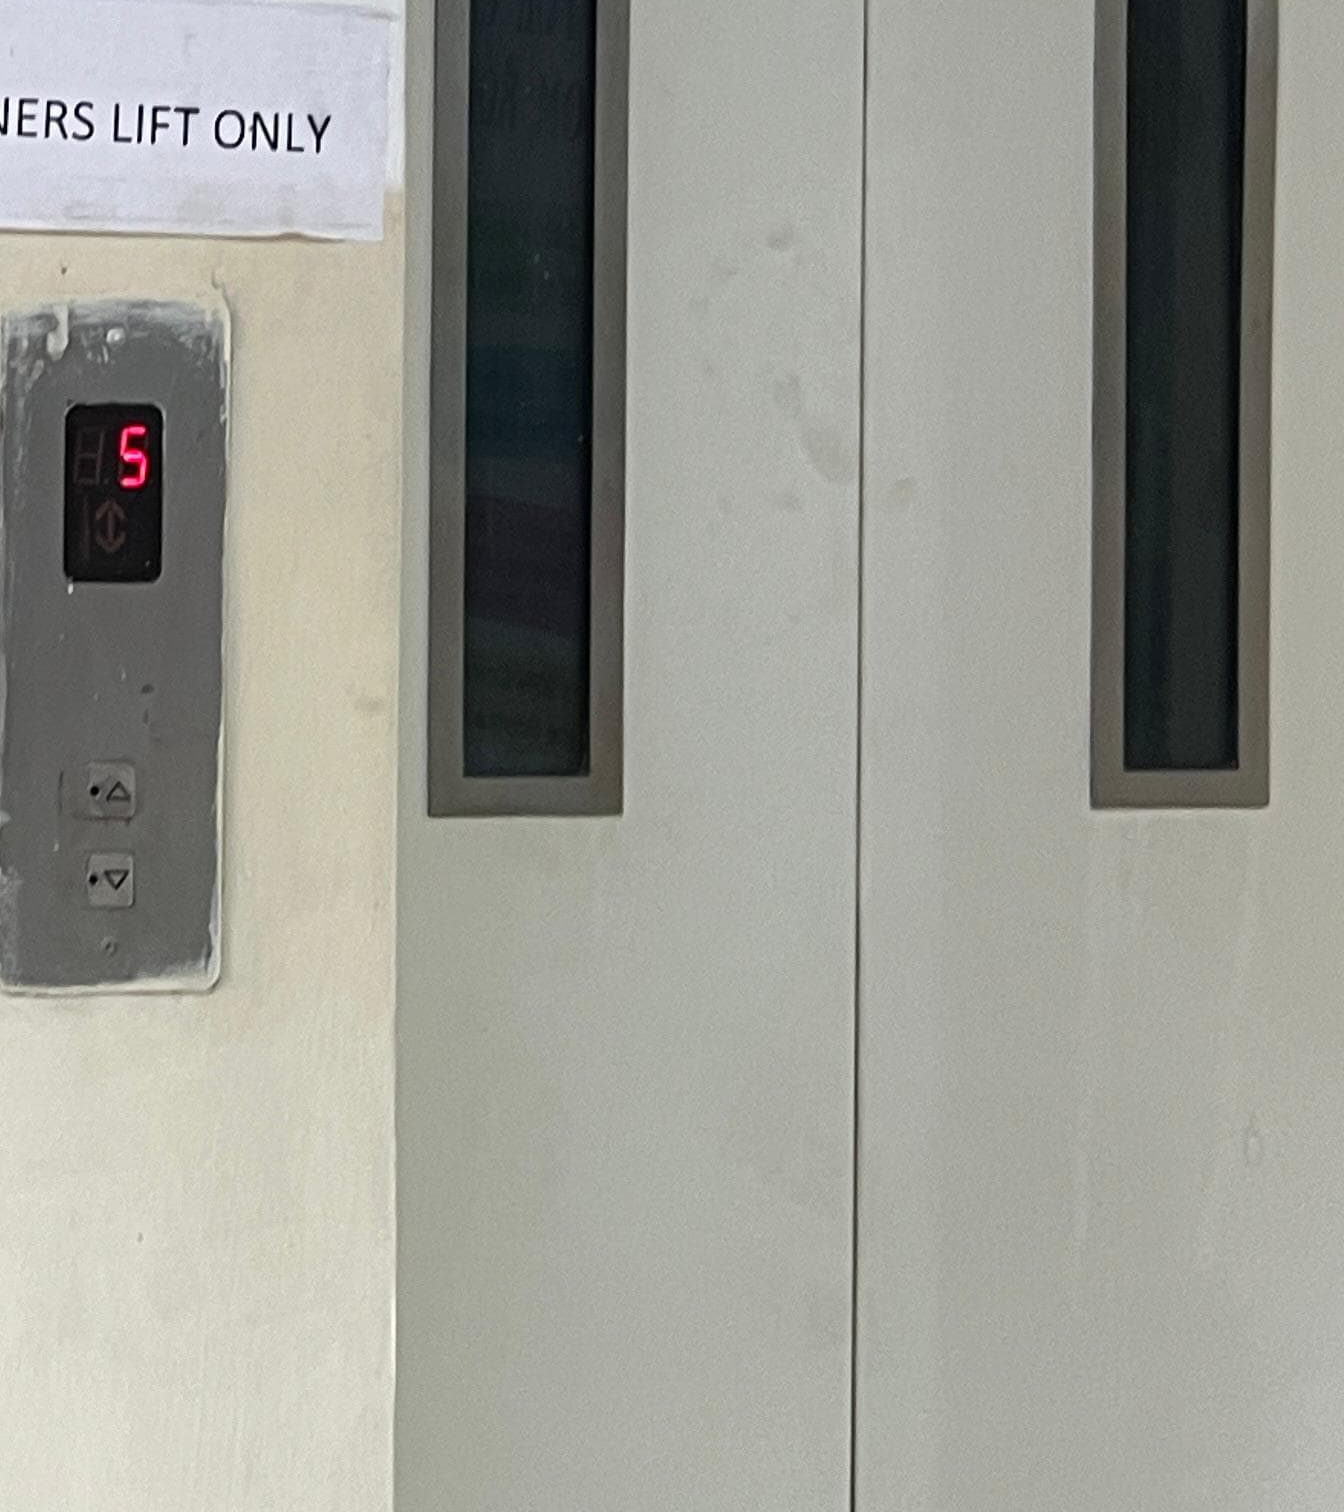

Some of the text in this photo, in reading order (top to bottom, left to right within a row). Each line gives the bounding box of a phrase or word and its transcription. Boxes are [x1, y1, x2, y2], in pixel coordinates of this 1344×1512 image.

[111, 102, 201, 147] LIFT
[212, 107, 333, 155] ONLY
[119, 425, 149, 488] 5
